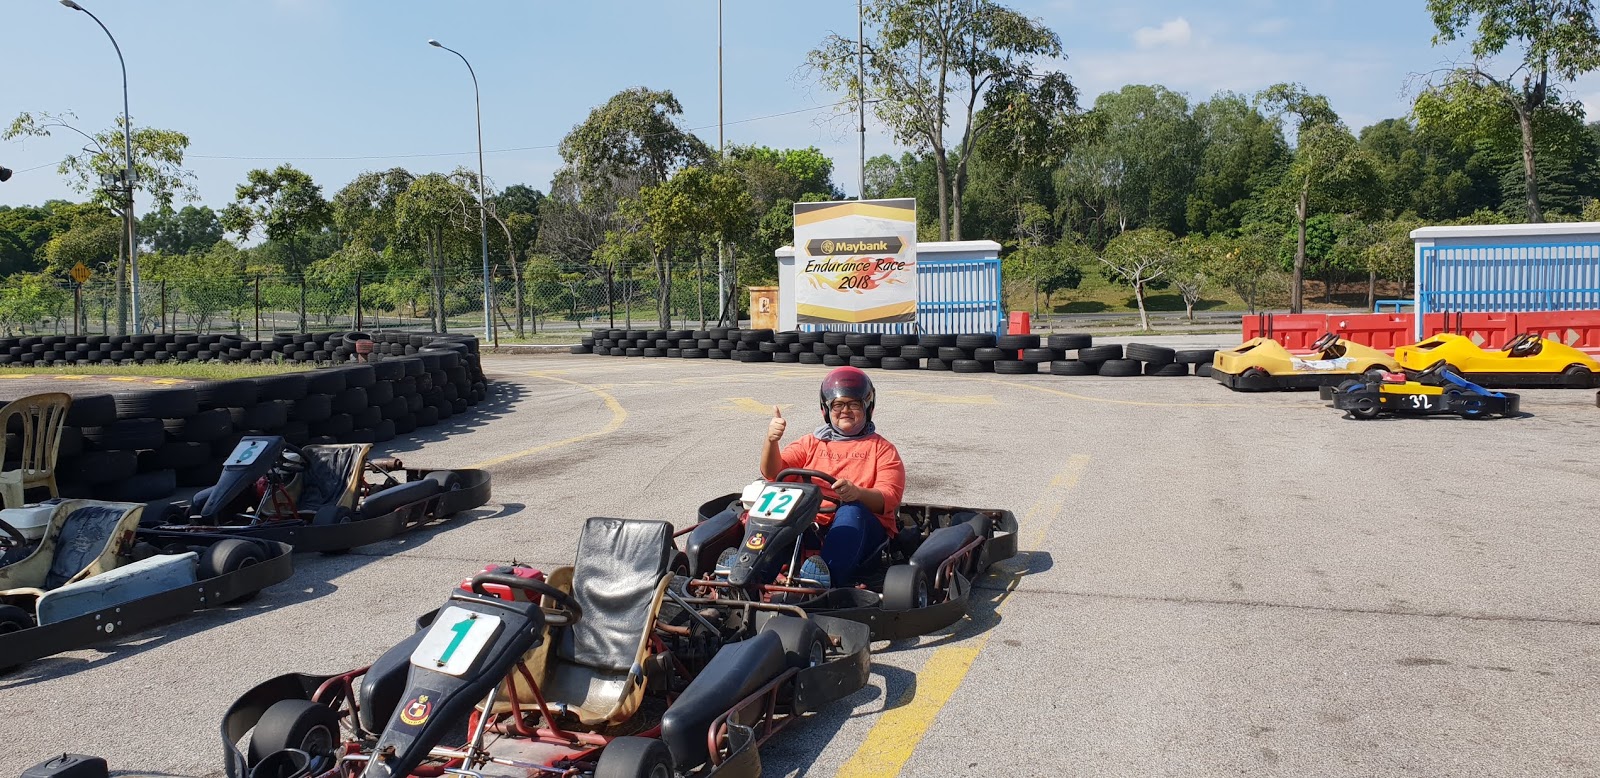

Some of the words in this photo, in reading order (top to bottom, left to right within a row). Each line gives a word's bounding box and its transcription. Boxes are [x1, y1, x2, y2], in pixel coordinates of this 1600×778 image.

[836, 241, 888, 253] Maybank
[805, 259, 870, 273] Endurance
[874, 258, 905, 271] Race
[838, 275, 871, 289] 2018
[1409, 394, 1433, 409] 32
[239, 445, 258, 461] 6
[757, 491, 793, 514] 12
[440, 619, 477, 663] 1
